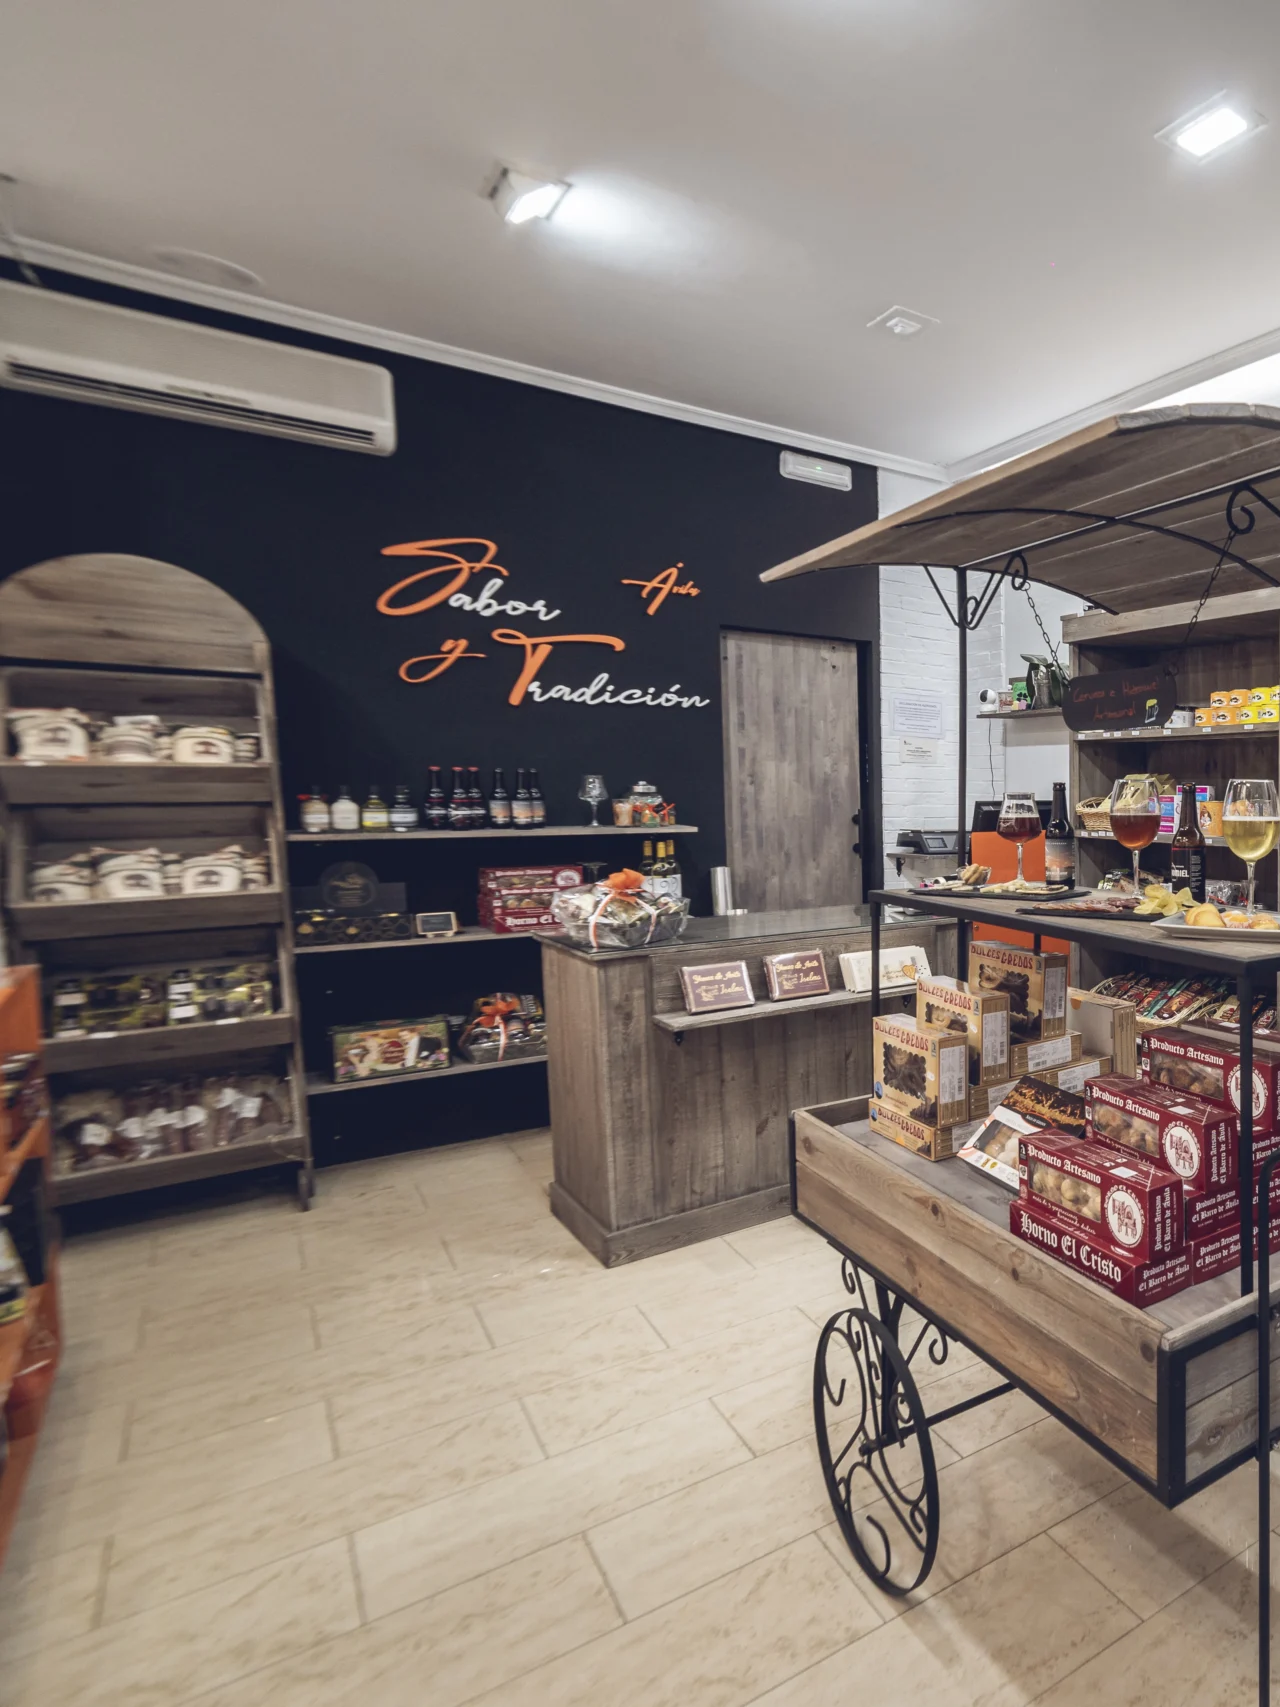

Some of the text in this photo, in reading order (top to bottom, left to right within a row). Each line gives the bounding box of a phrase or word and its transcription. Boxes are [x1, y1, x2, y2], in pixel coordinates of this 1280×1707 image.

[376, 537, 561, 621] Sabor
[399, 628, 710, 707] y Tradición
[505, 916, 538, 928] Horno
[971, 945, 1033, 970] DULCES GREDOS
[918, 983, 972, 1011] DULCES GREDOS
[875, 1021, 929, 1051] DULCES GREDOS
[1150, 1037, 1224, 1066] Producto Artesano
[1092, 1085, 1160, 1121] Producto Artesano
[877, 1107, 925, 1141] DULCES GREDOS
[1027, 1143, 1101, 1184] Producto Artesano
[1162, 1187, 1171, 1207] Ávila
[1195, 1190, 1236, 1211] Producto Artesano
[1164, 1208, 1171, 1218] de
[1192, 1213, 1199, 1223] El
[1218, 1205, 1225, 1214] de
[1020, 1211, 1122, 1282] Horno El Cristo
[1164, 1243, 1171, 1252] El
[1195, 1259, 1204, 1268] El
[1222, 1247, 1229, 1257] de
[1229, 1243, 1242, 1254] Ávil
[1200, 1233, 1240, 1256] Producto Artesano
[1139, 1282, 1147, 1291] El
[1174, 1264, 1190, 1276] Ávila
[1143, 1255, 1186, 1280] Producto Artesano
